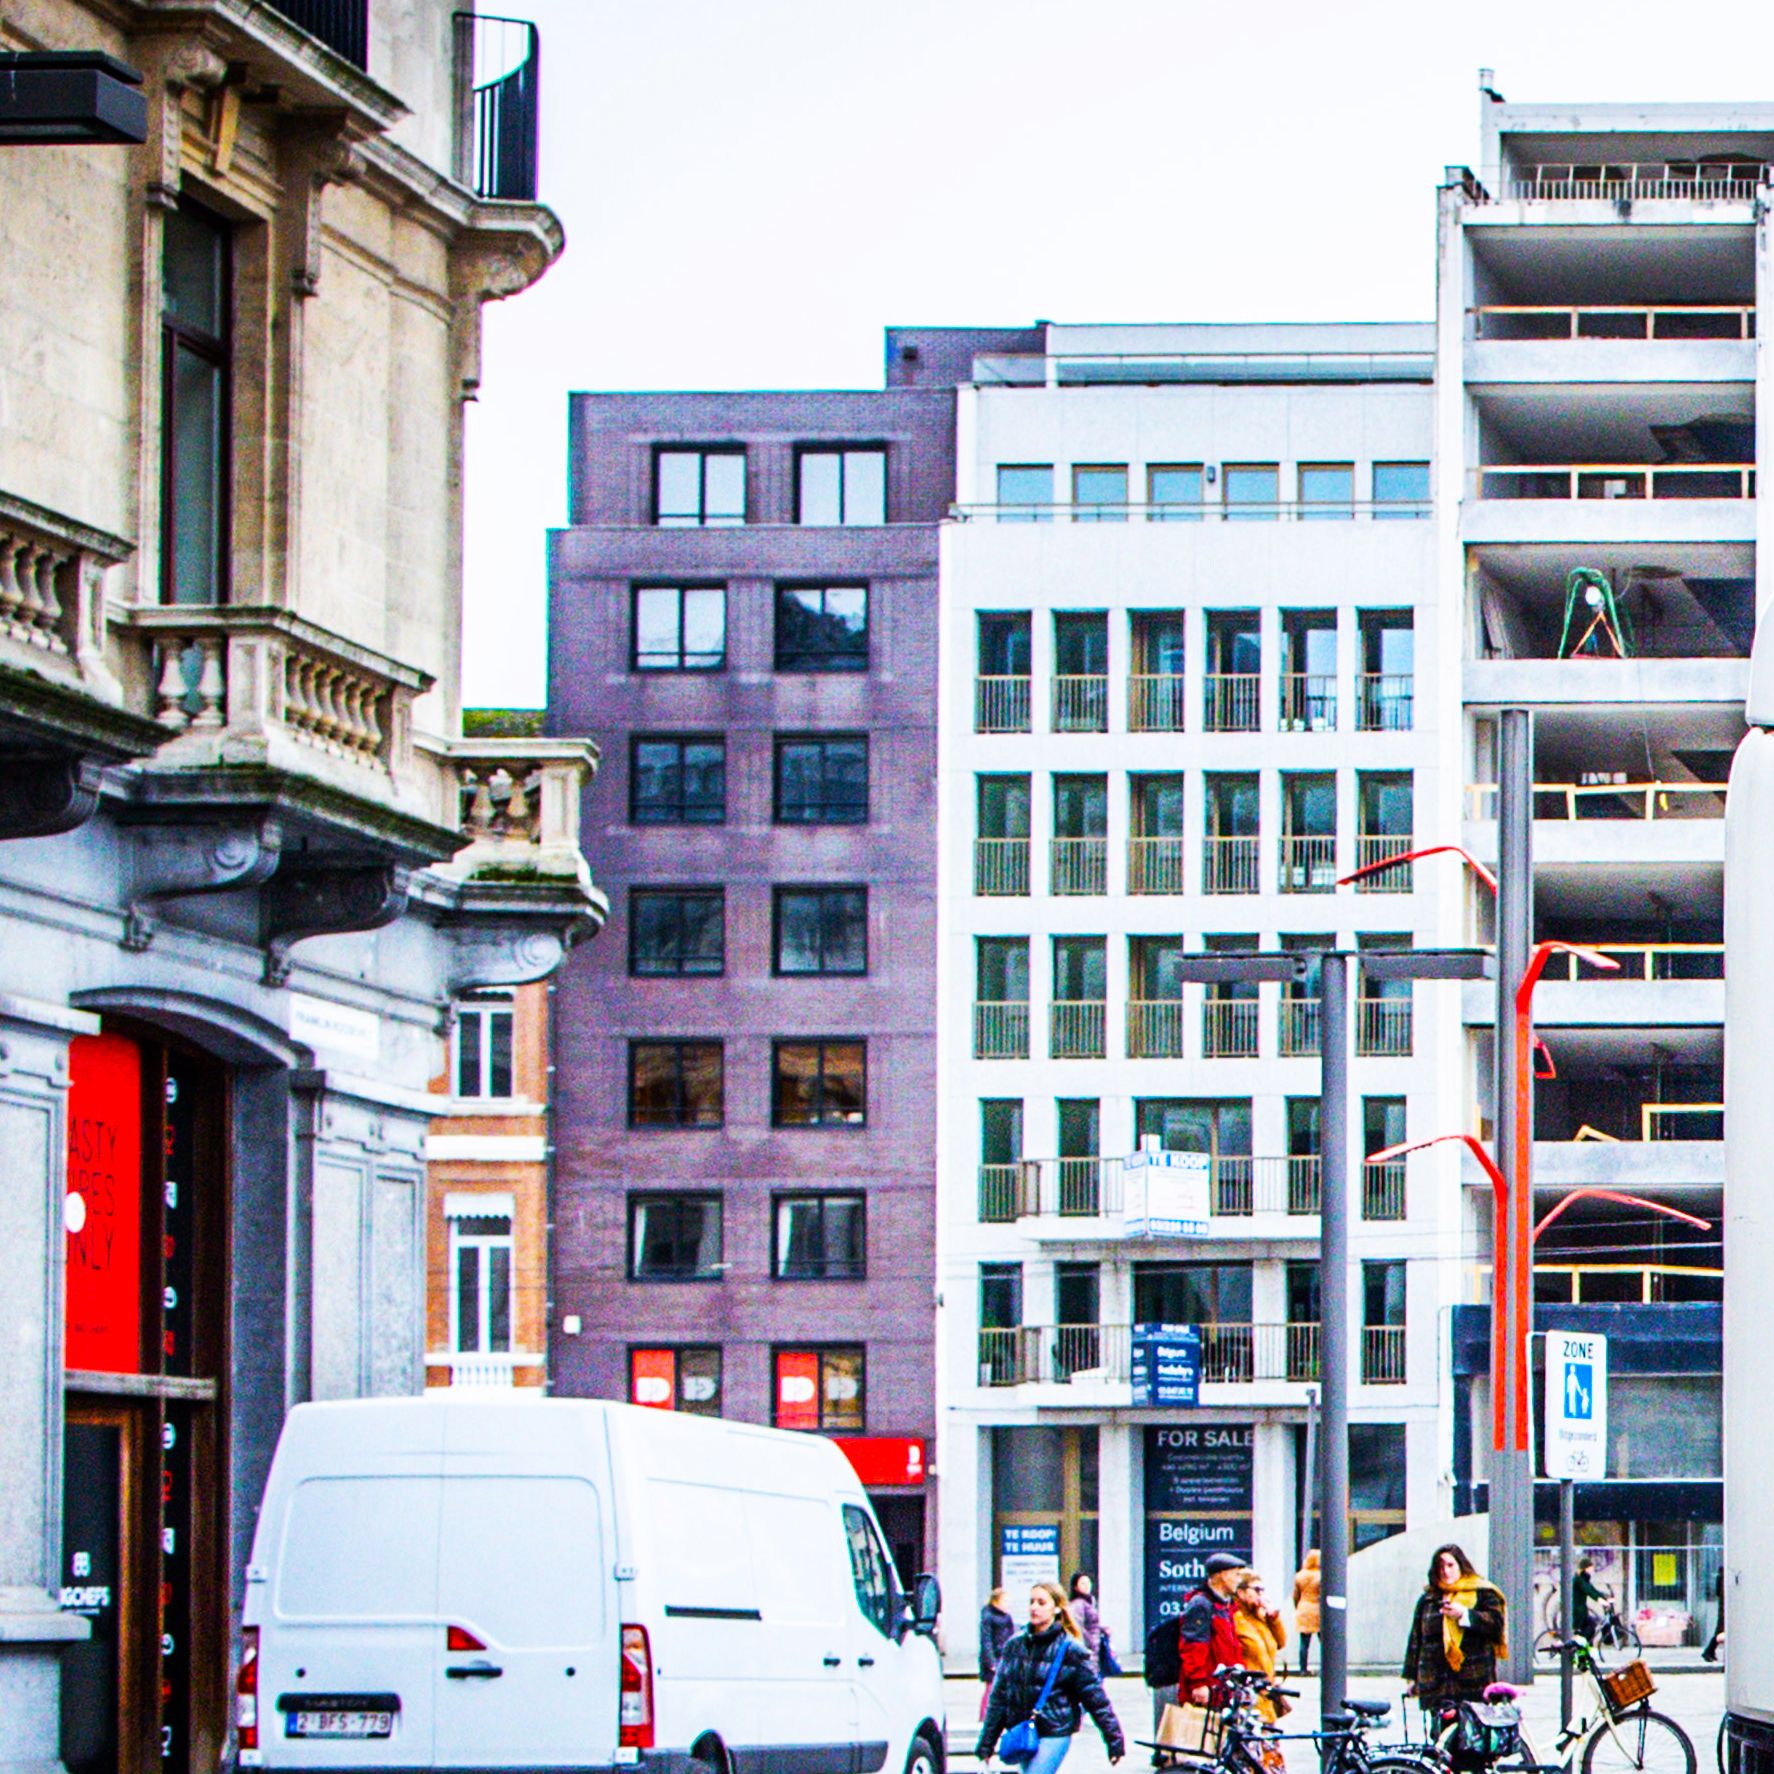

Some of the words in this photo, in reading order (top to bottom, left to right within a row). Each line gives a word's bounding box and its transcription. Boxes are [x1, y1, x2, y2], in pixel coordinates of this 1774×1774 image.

[1563, 1340, 1594, 1359] ZONE
[1158, 1430, 1198, 1447] FOR
[1204, 1430, 1253, 1447] SALE
[1160, 1523, 1235, 1545] Belgium
[1159, 1558, 1205, 1578] Soth
